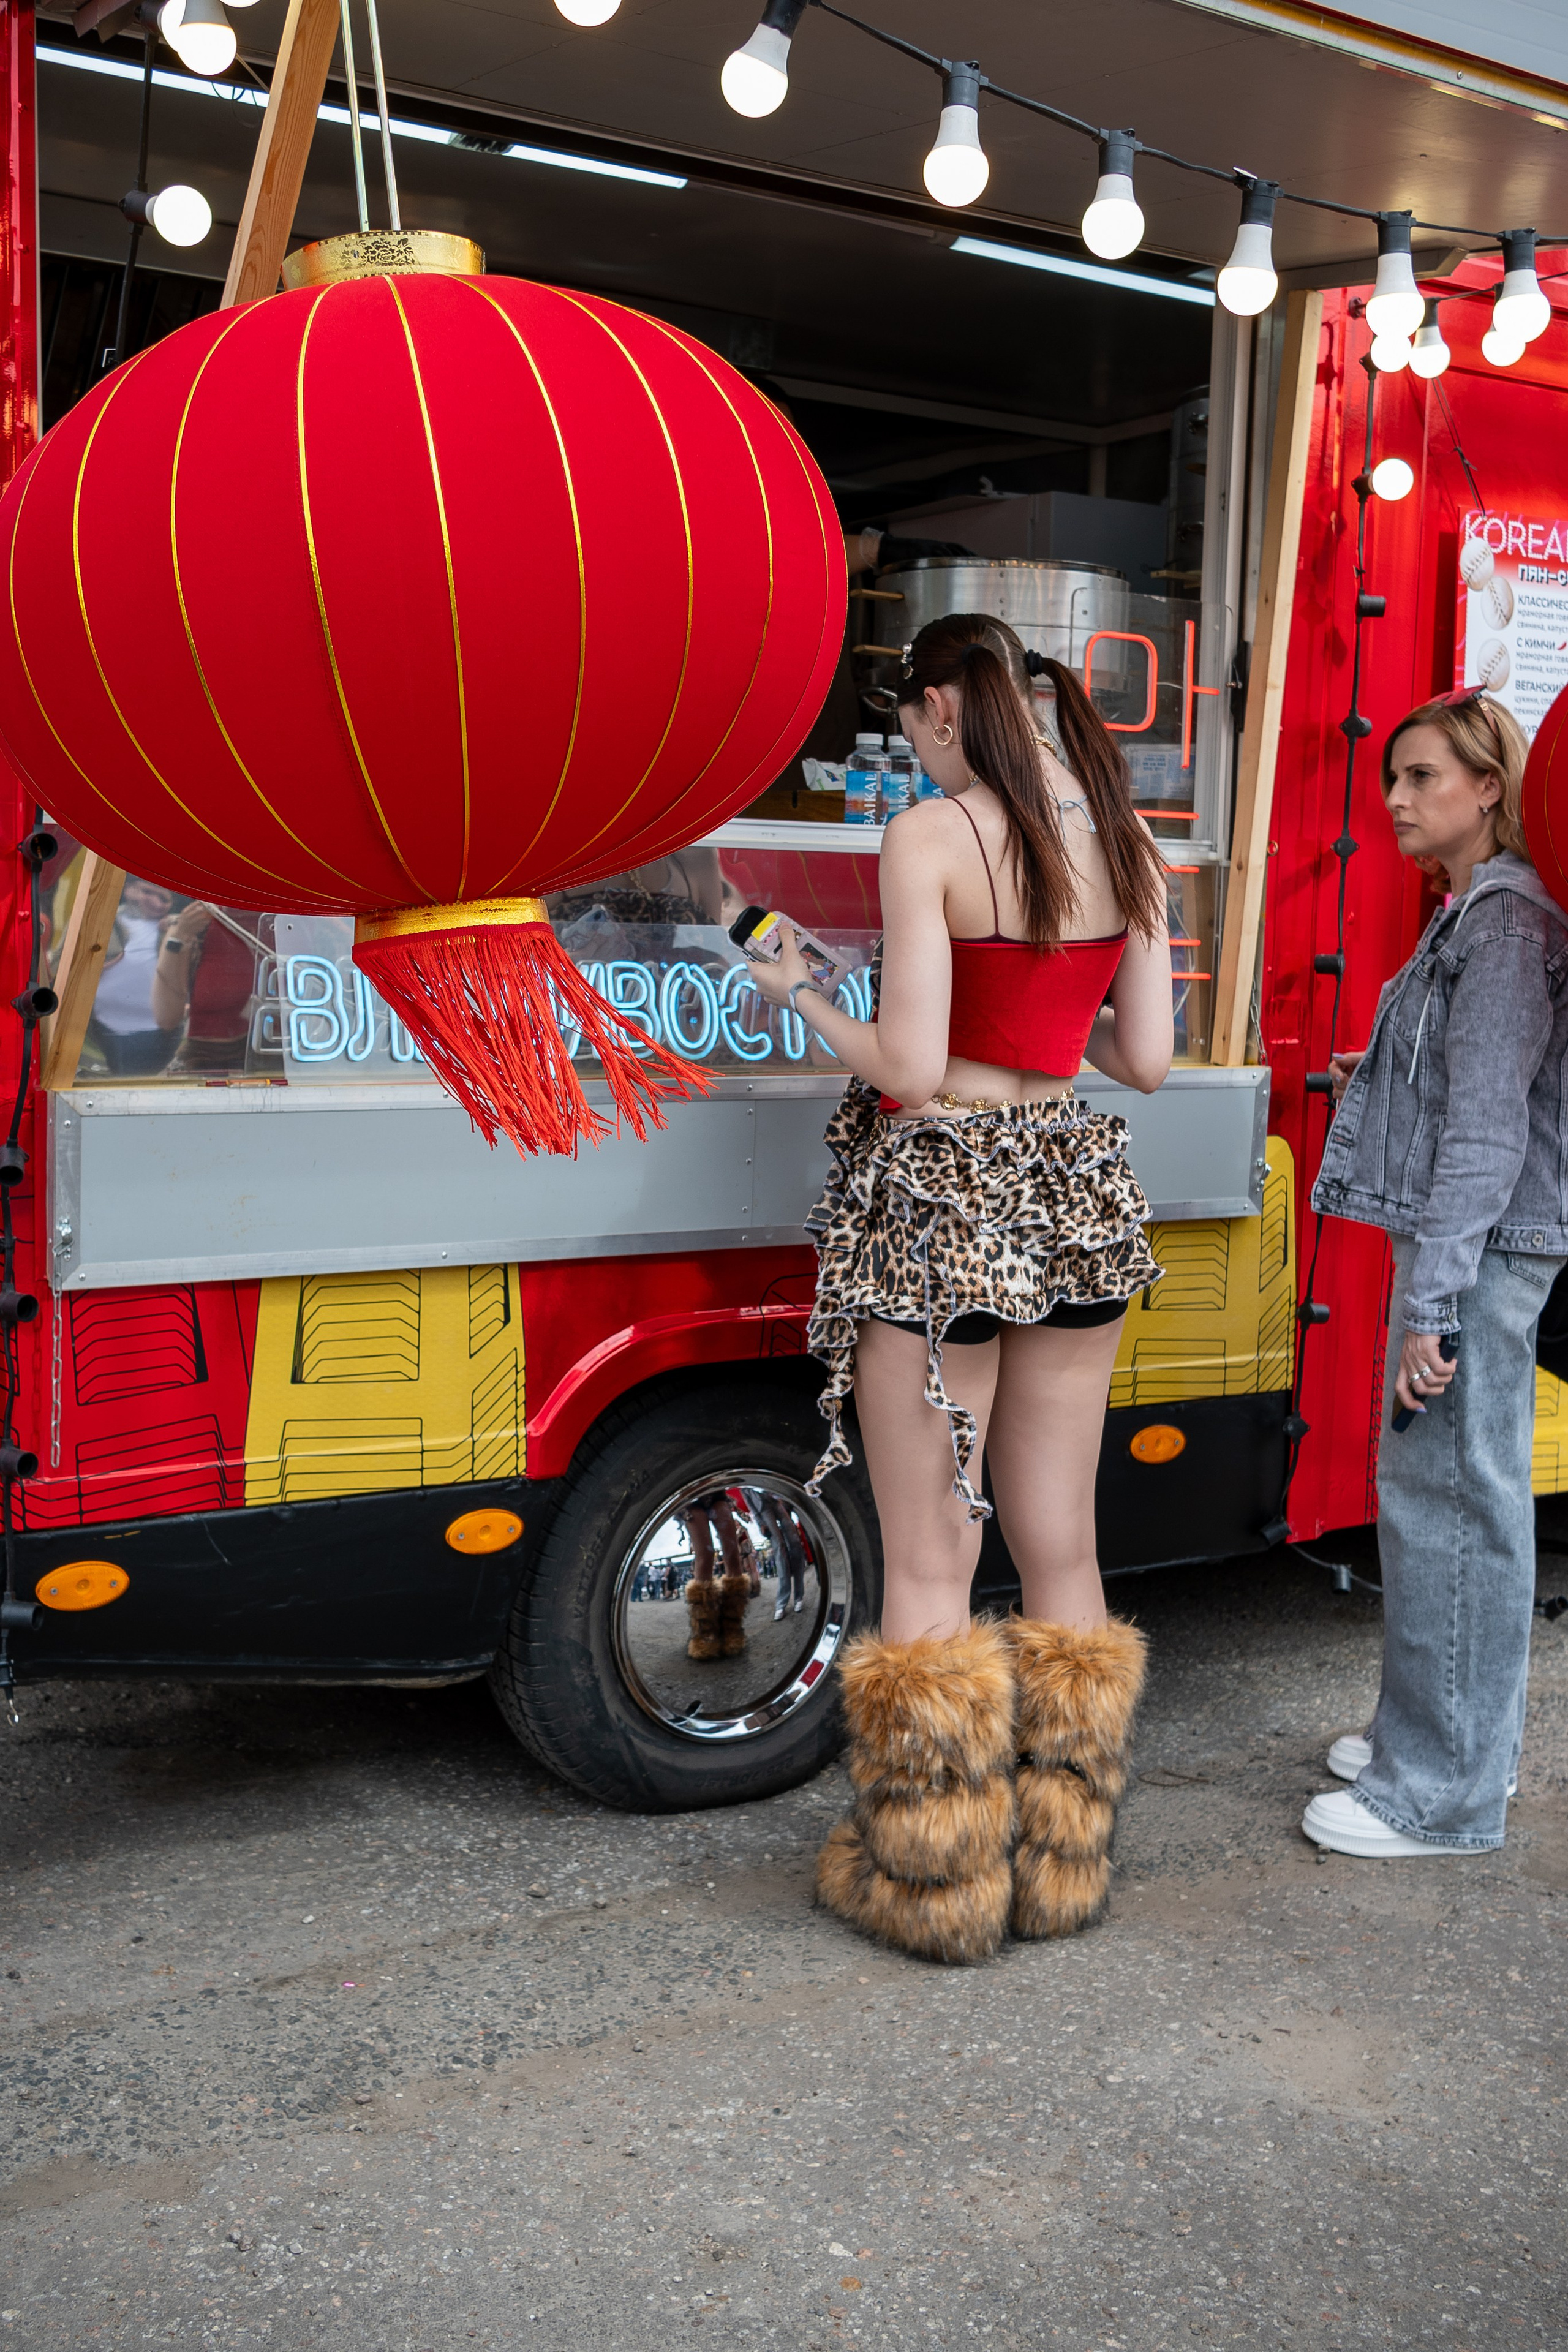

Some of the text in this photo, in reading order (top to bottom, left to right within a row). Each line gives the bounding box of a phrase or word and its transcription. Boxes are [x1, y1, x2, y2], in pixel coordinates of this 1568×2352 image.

[1465, 513, 1568, 564] KOREA
[1518, 564, 1568, 586] ПЯН-С
[1517, 636, 1555, 651] С КИМЧИ
[864, 773, 877, 825] BAIKAL
[898, 775, 910, 809] IKAL
